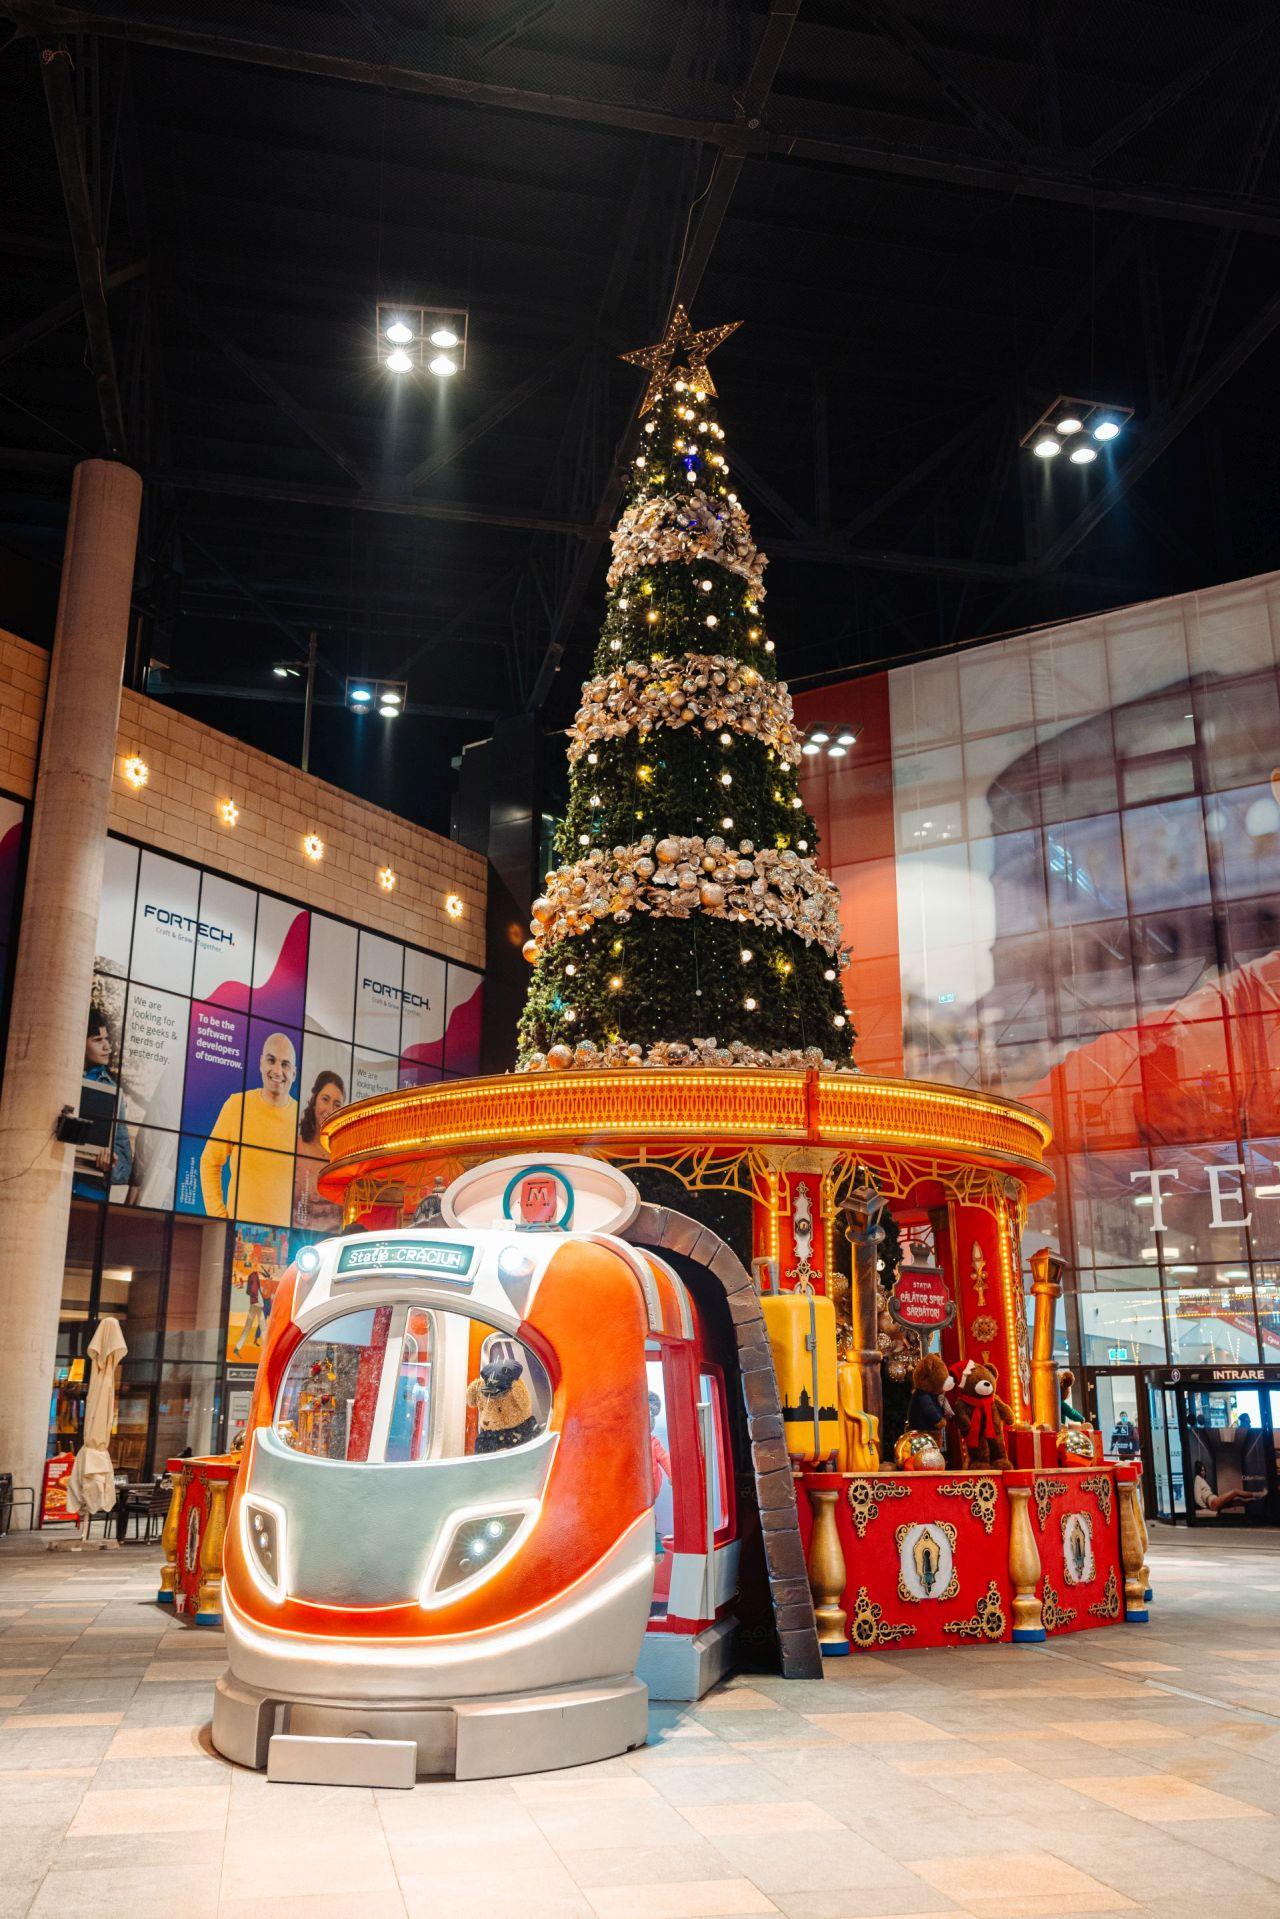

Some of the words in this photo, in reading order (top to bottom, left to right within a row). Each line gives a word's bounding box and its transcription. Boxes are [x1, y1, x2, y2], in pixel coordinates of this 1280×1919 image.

[134, 996, 147, 1007] We
[148, 1001, 162, 1011] are
[132, 1008, 162, 1025] looking
[163, 1015, 176, 1027] for
[198, 1013, 209, 1024] To
[210, 1016, 221, 1028] be
[221, 1019, 236, 1031] the
[131, 1021, 145, 1031] the
[146, 1027, 169, 1038] geeks
[171, 1031, 178, 1040] &
[197, 1026, 233, 1043] software
[130, 1034, 153, 1047] nerds
[155, 1041, 165, 1049] of
[196, 1037, 240, 1057] developers
[195, 1050, 205, 1060] of
[204, 1052, 243, 1070] tomorrow.
[1130, 1161, 1280, 1231] TE
[1213, 1369, 1265, 1380] INTRARE
